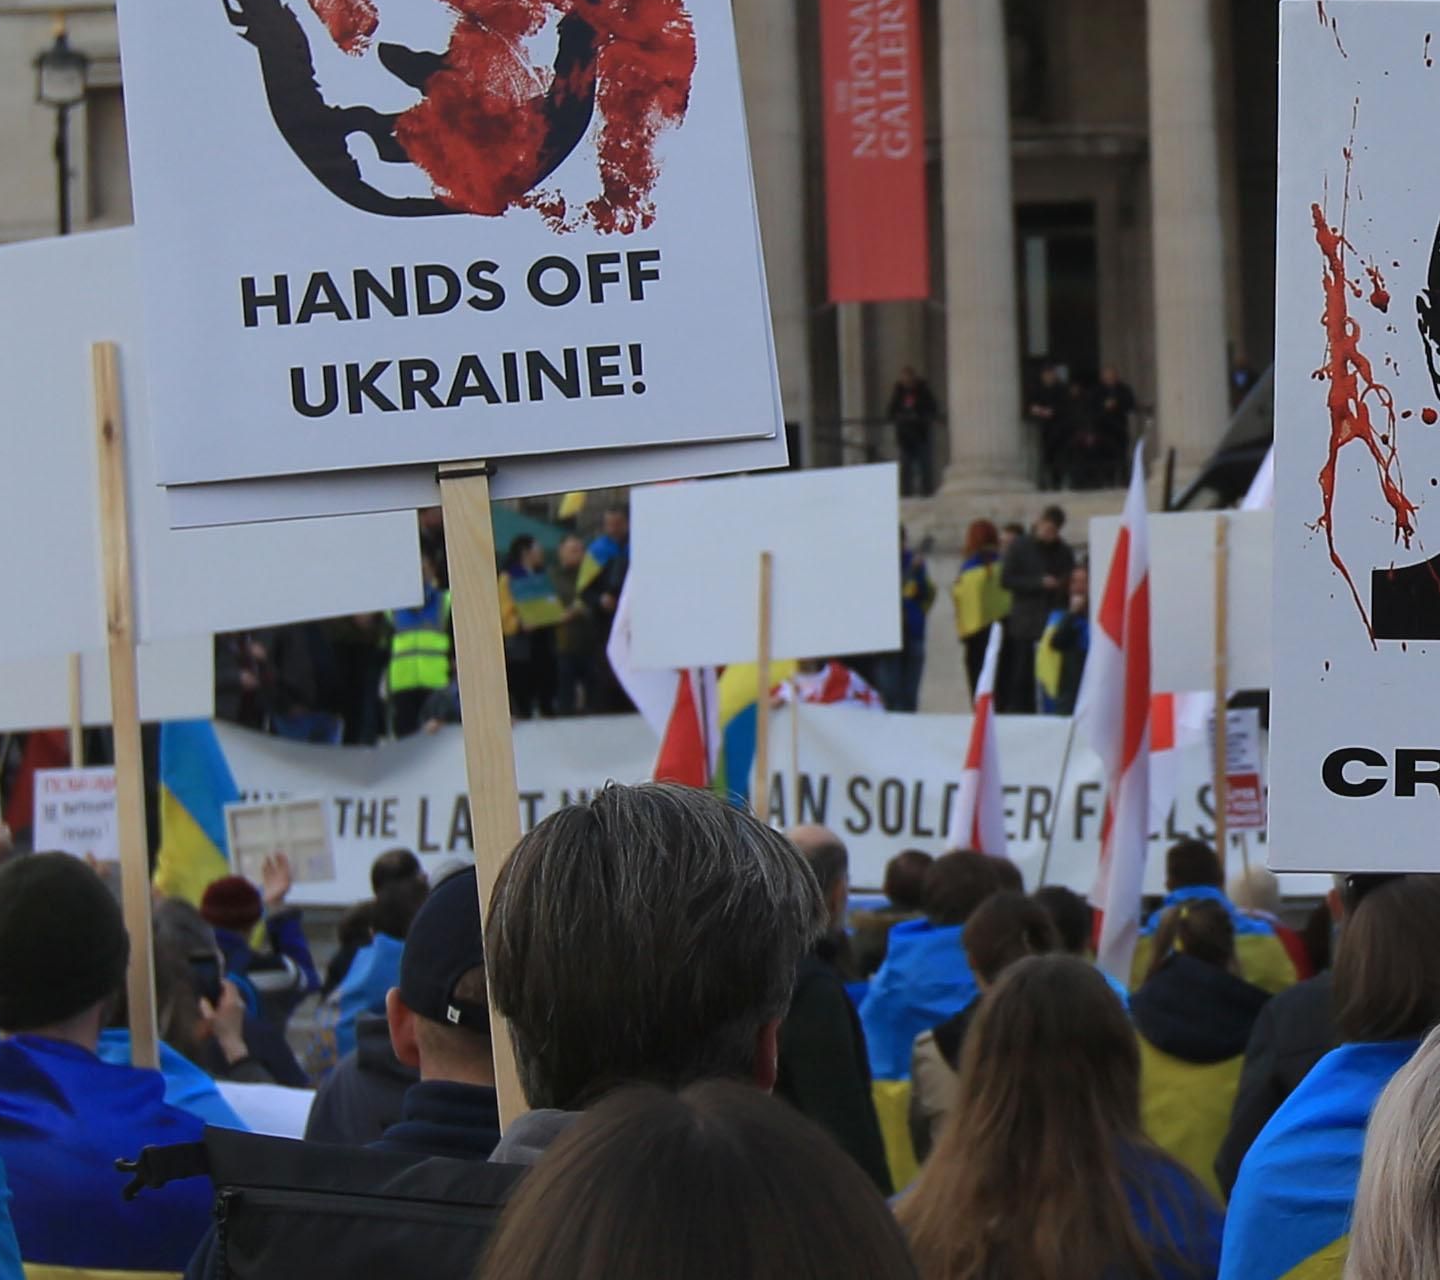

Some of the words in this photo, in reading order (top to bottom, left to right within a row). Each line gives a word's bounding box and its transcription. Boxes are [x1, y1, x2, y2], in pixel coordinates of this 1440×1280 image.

[240, 260, 505, 328] HANDS
[526, 249, 663, 307] OFF
[289, 343, 647, 419] UKRAINE!
[334, 797, 400, 838] THE
[419, 792, 545, 852] LAT
[843, 776, 1053, 840] SOLER
[1074, 782, 1239, 848] FLS,
